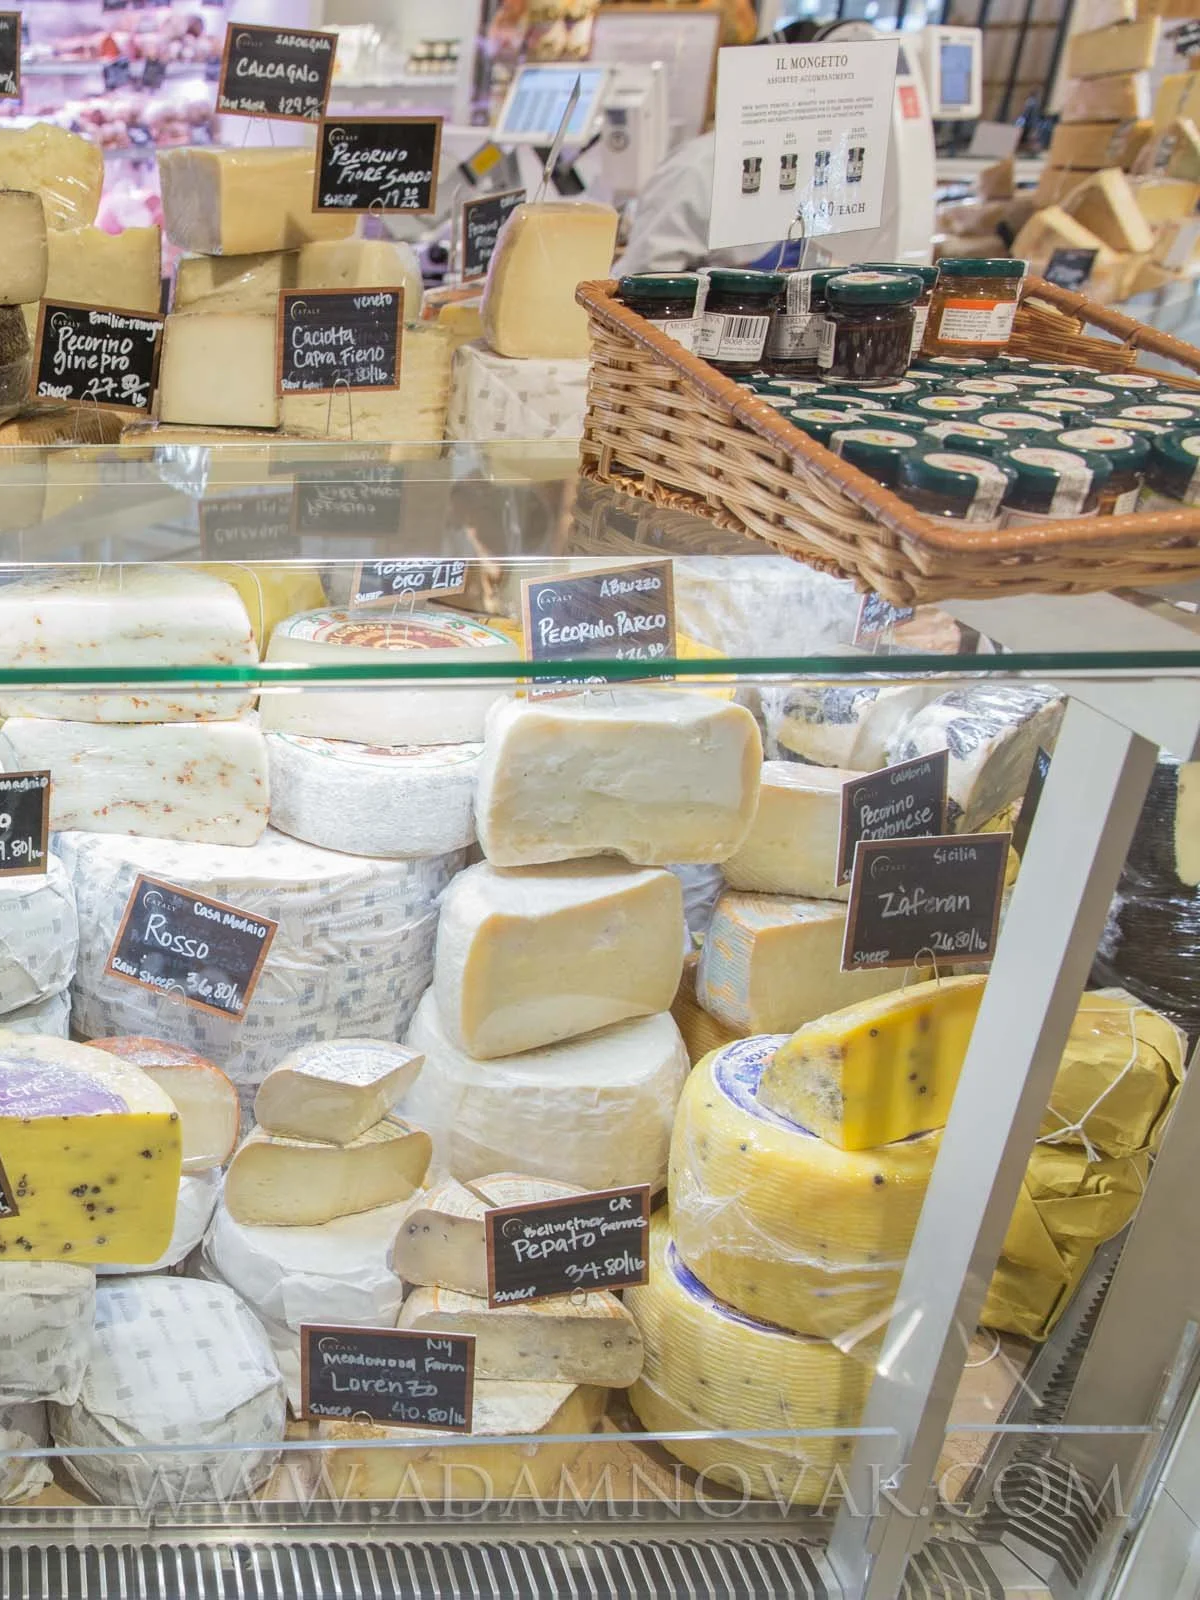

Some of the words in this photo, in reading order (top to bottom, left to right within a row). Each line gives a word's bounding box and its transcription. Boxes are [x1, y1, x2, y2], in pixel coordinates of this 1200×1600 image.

[236, 57, 319, 84] CALCAGNO
[776, 58, 787, 70] IL
[790, 55, 848, 70] MONGETTO
[329, 142, 408, 166] PECORINO
[337, 163, 387, 184] FIORE
[58, 326, 133, 354] Pecorino
[292, 326, 356, 348] Caciotta
[53, 350, 130, 376] ginepro
[294, 349, 336, 368] Capra
[392, 573, 425, 590] ORO
[600, 577, 661, 598] ABRUZZO
[538, 617, 615, 647] PECORINO
[614, 610, 666, 637] PARCO
[860, 795, 914, 828] Pecorino
[609, 1197, 632, 1212] CA
[512, 1227, 596, 1262] Pepato
[564, 1250, 645, 1283] 34.80/lb
[426, 1338, 453, 1357] NY
[331, 1371, 438, 1397] Lorenzo
